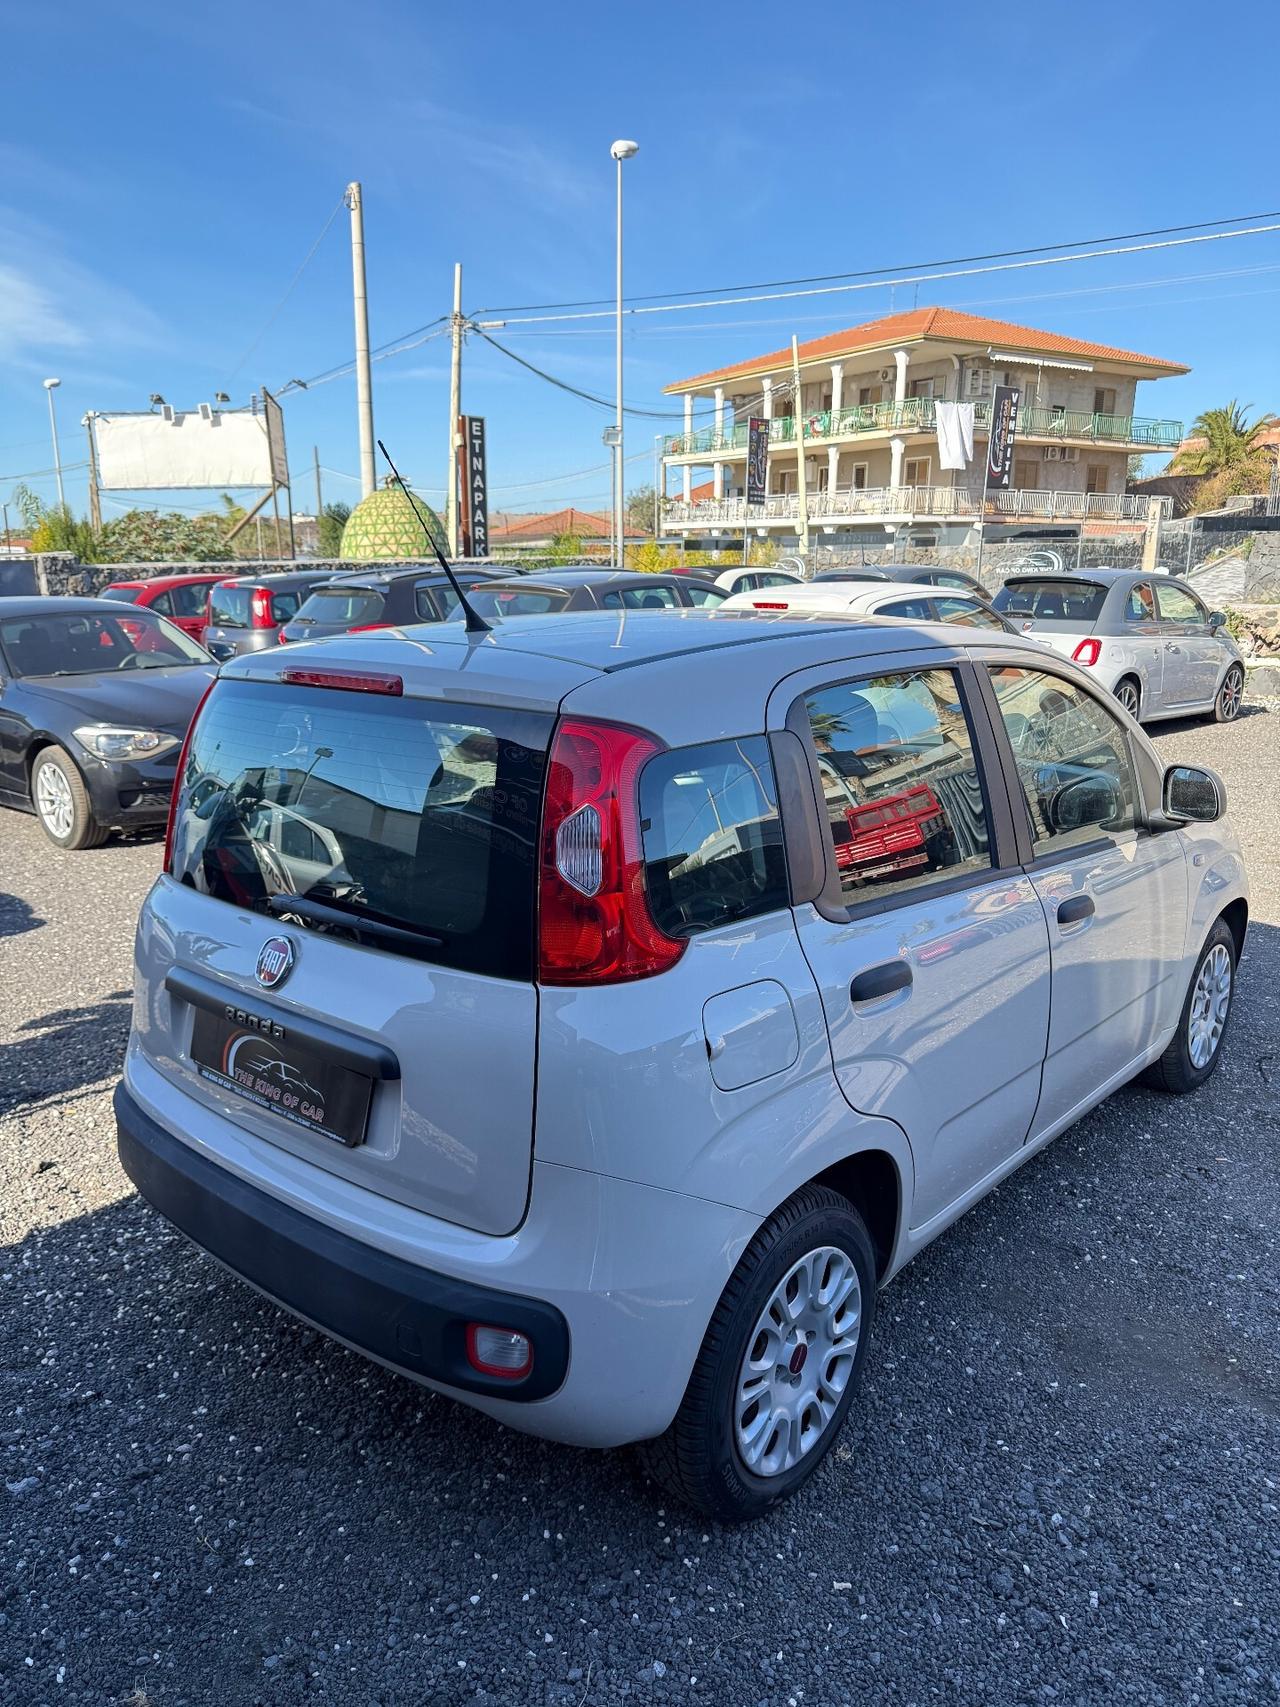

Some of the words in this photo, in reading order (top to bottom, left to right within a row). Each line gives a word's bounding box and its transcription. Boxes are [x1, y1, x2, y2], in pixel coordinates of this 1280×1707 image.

[1002, 392, 1018, 485] VENDITA
[261, 948, 286, 974] FIAT
[234, 1067, 255, 1087] THE
[254, 1078, 281, 1101] KING
[282, 1092, 300, 1108] OF
[300, 1101, 325, 1123] CAR
